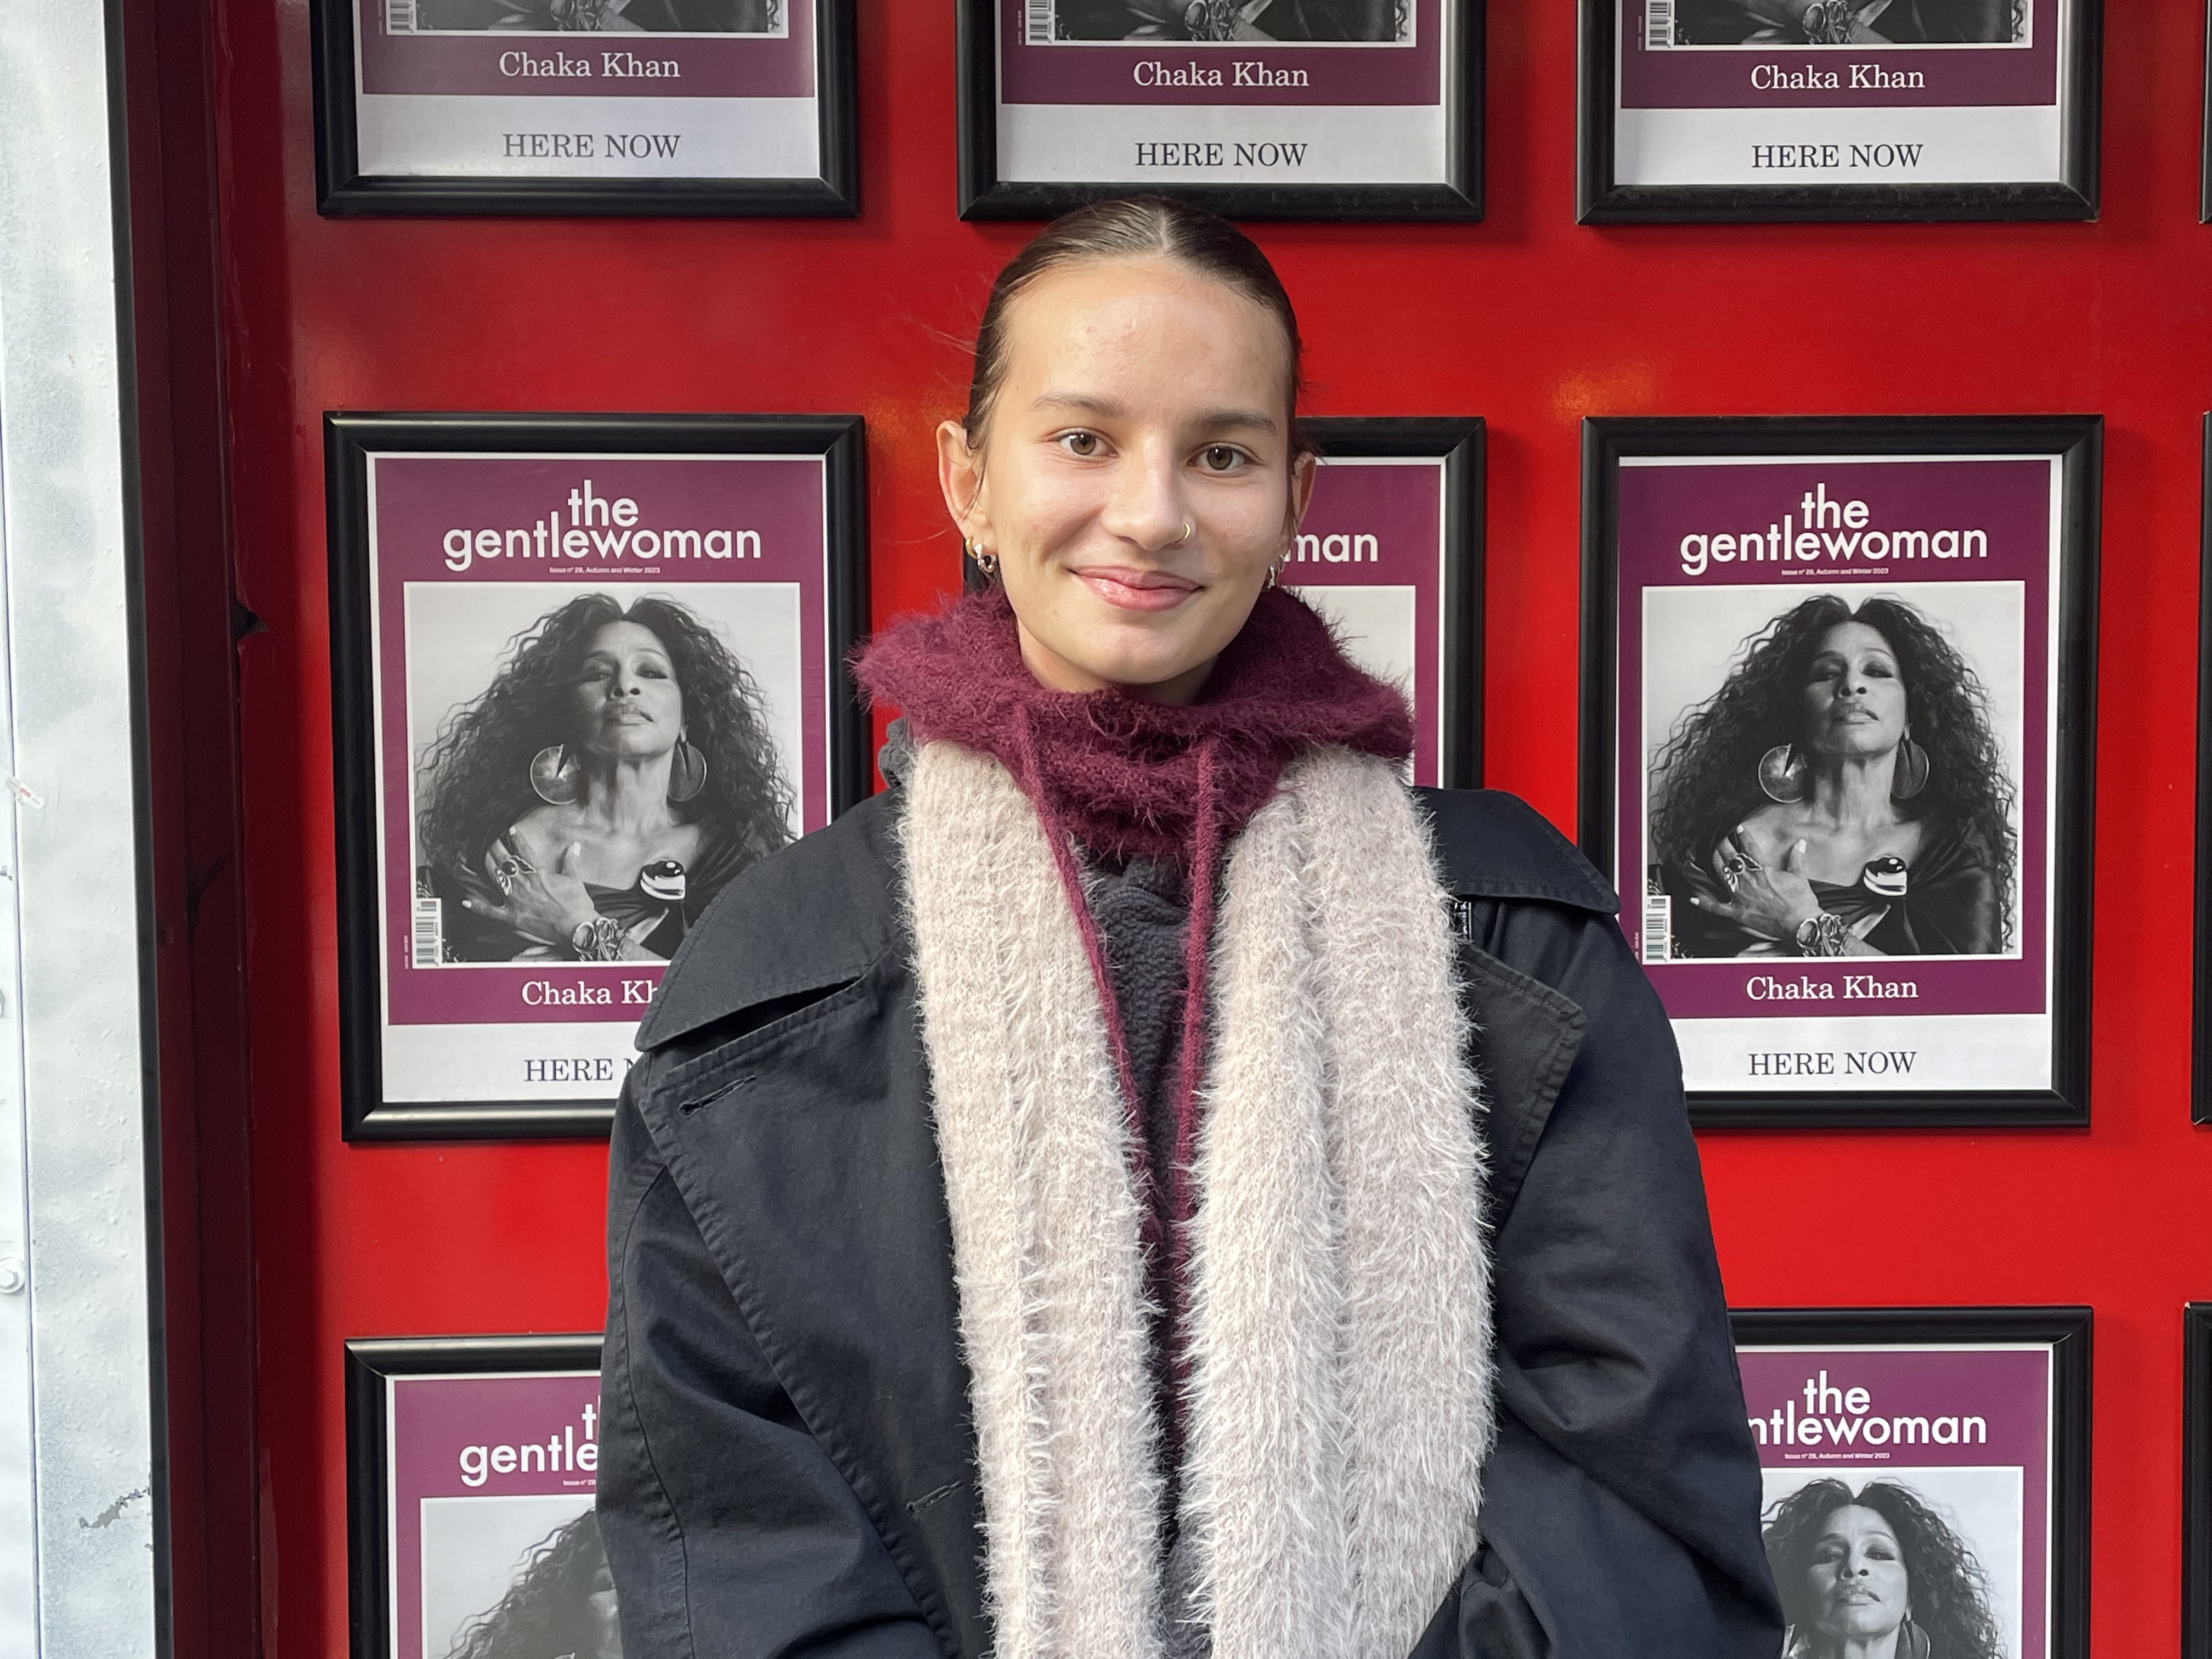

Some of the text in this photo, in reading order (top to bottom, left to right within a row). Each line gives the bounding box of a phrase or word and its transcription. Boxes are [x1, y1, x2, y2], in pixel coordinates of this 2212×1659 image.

[499, 51, 681, 78] Chaka Khan
[1133, 61, 1310, 87] Chaka Khan
[1751, 64, 1926, 89] Chaka Khan
[503, 134, 681, 159] HERE NOW
[1135, 143, 1308, 167] HERE NOW
[1752, 144, 1924, 168] HERE NOW
[567, 479, 639, 526] the
[1801, 483, 1869, 529] the
[443, 511, 761, 572] gentlewoman
[1680, 515, 1987, 576] gentlewoman
[522, 980, 658, 1005] Chaka Kh
[1746, 975, 1919, 1000] Chaka Khan
[524, 1058, 613, 1082] HERE
[1748, 1051, 1917, 1076] HERE NOW
[1803, 1370, 1870, 1415] the
[1748, 1400, 1987, 1446] ntlewoman
[459, 1426, 598, 1487] gentle
